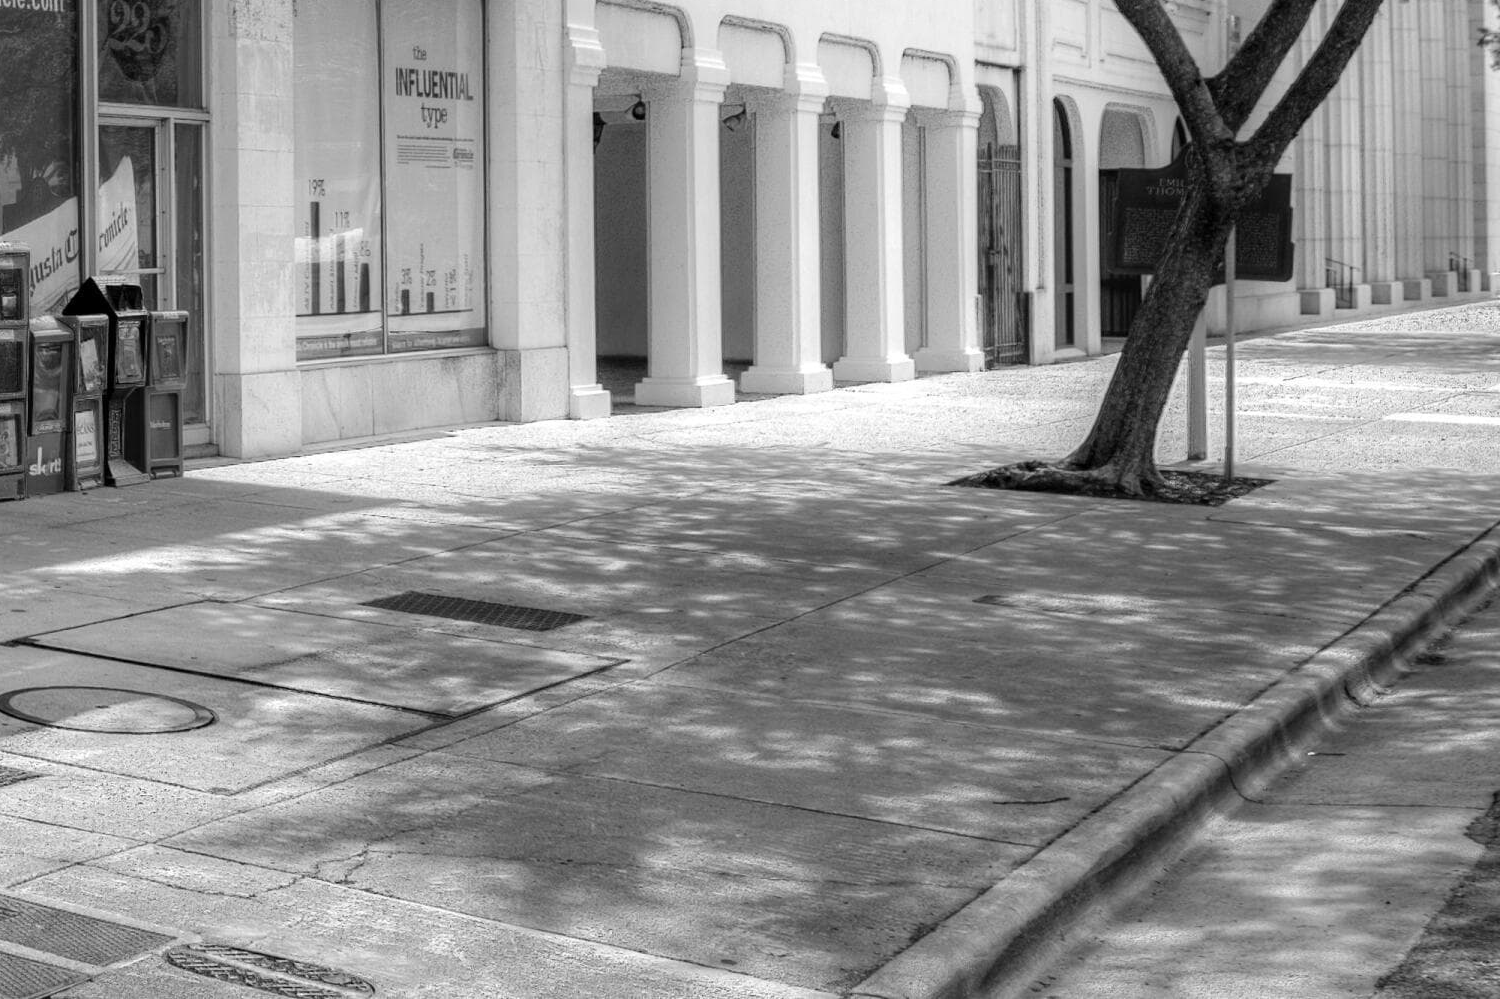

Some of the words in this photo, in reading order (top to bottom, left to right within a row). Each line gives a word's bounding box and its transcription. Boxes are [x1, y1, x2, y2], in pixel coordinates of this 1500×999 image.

[412, 45, 428, 61] the
[395, 67, 474, 101] INFLUENTIAL
[420, 103, 448, 130] type
[28, 446, 62, 477] skrt!
